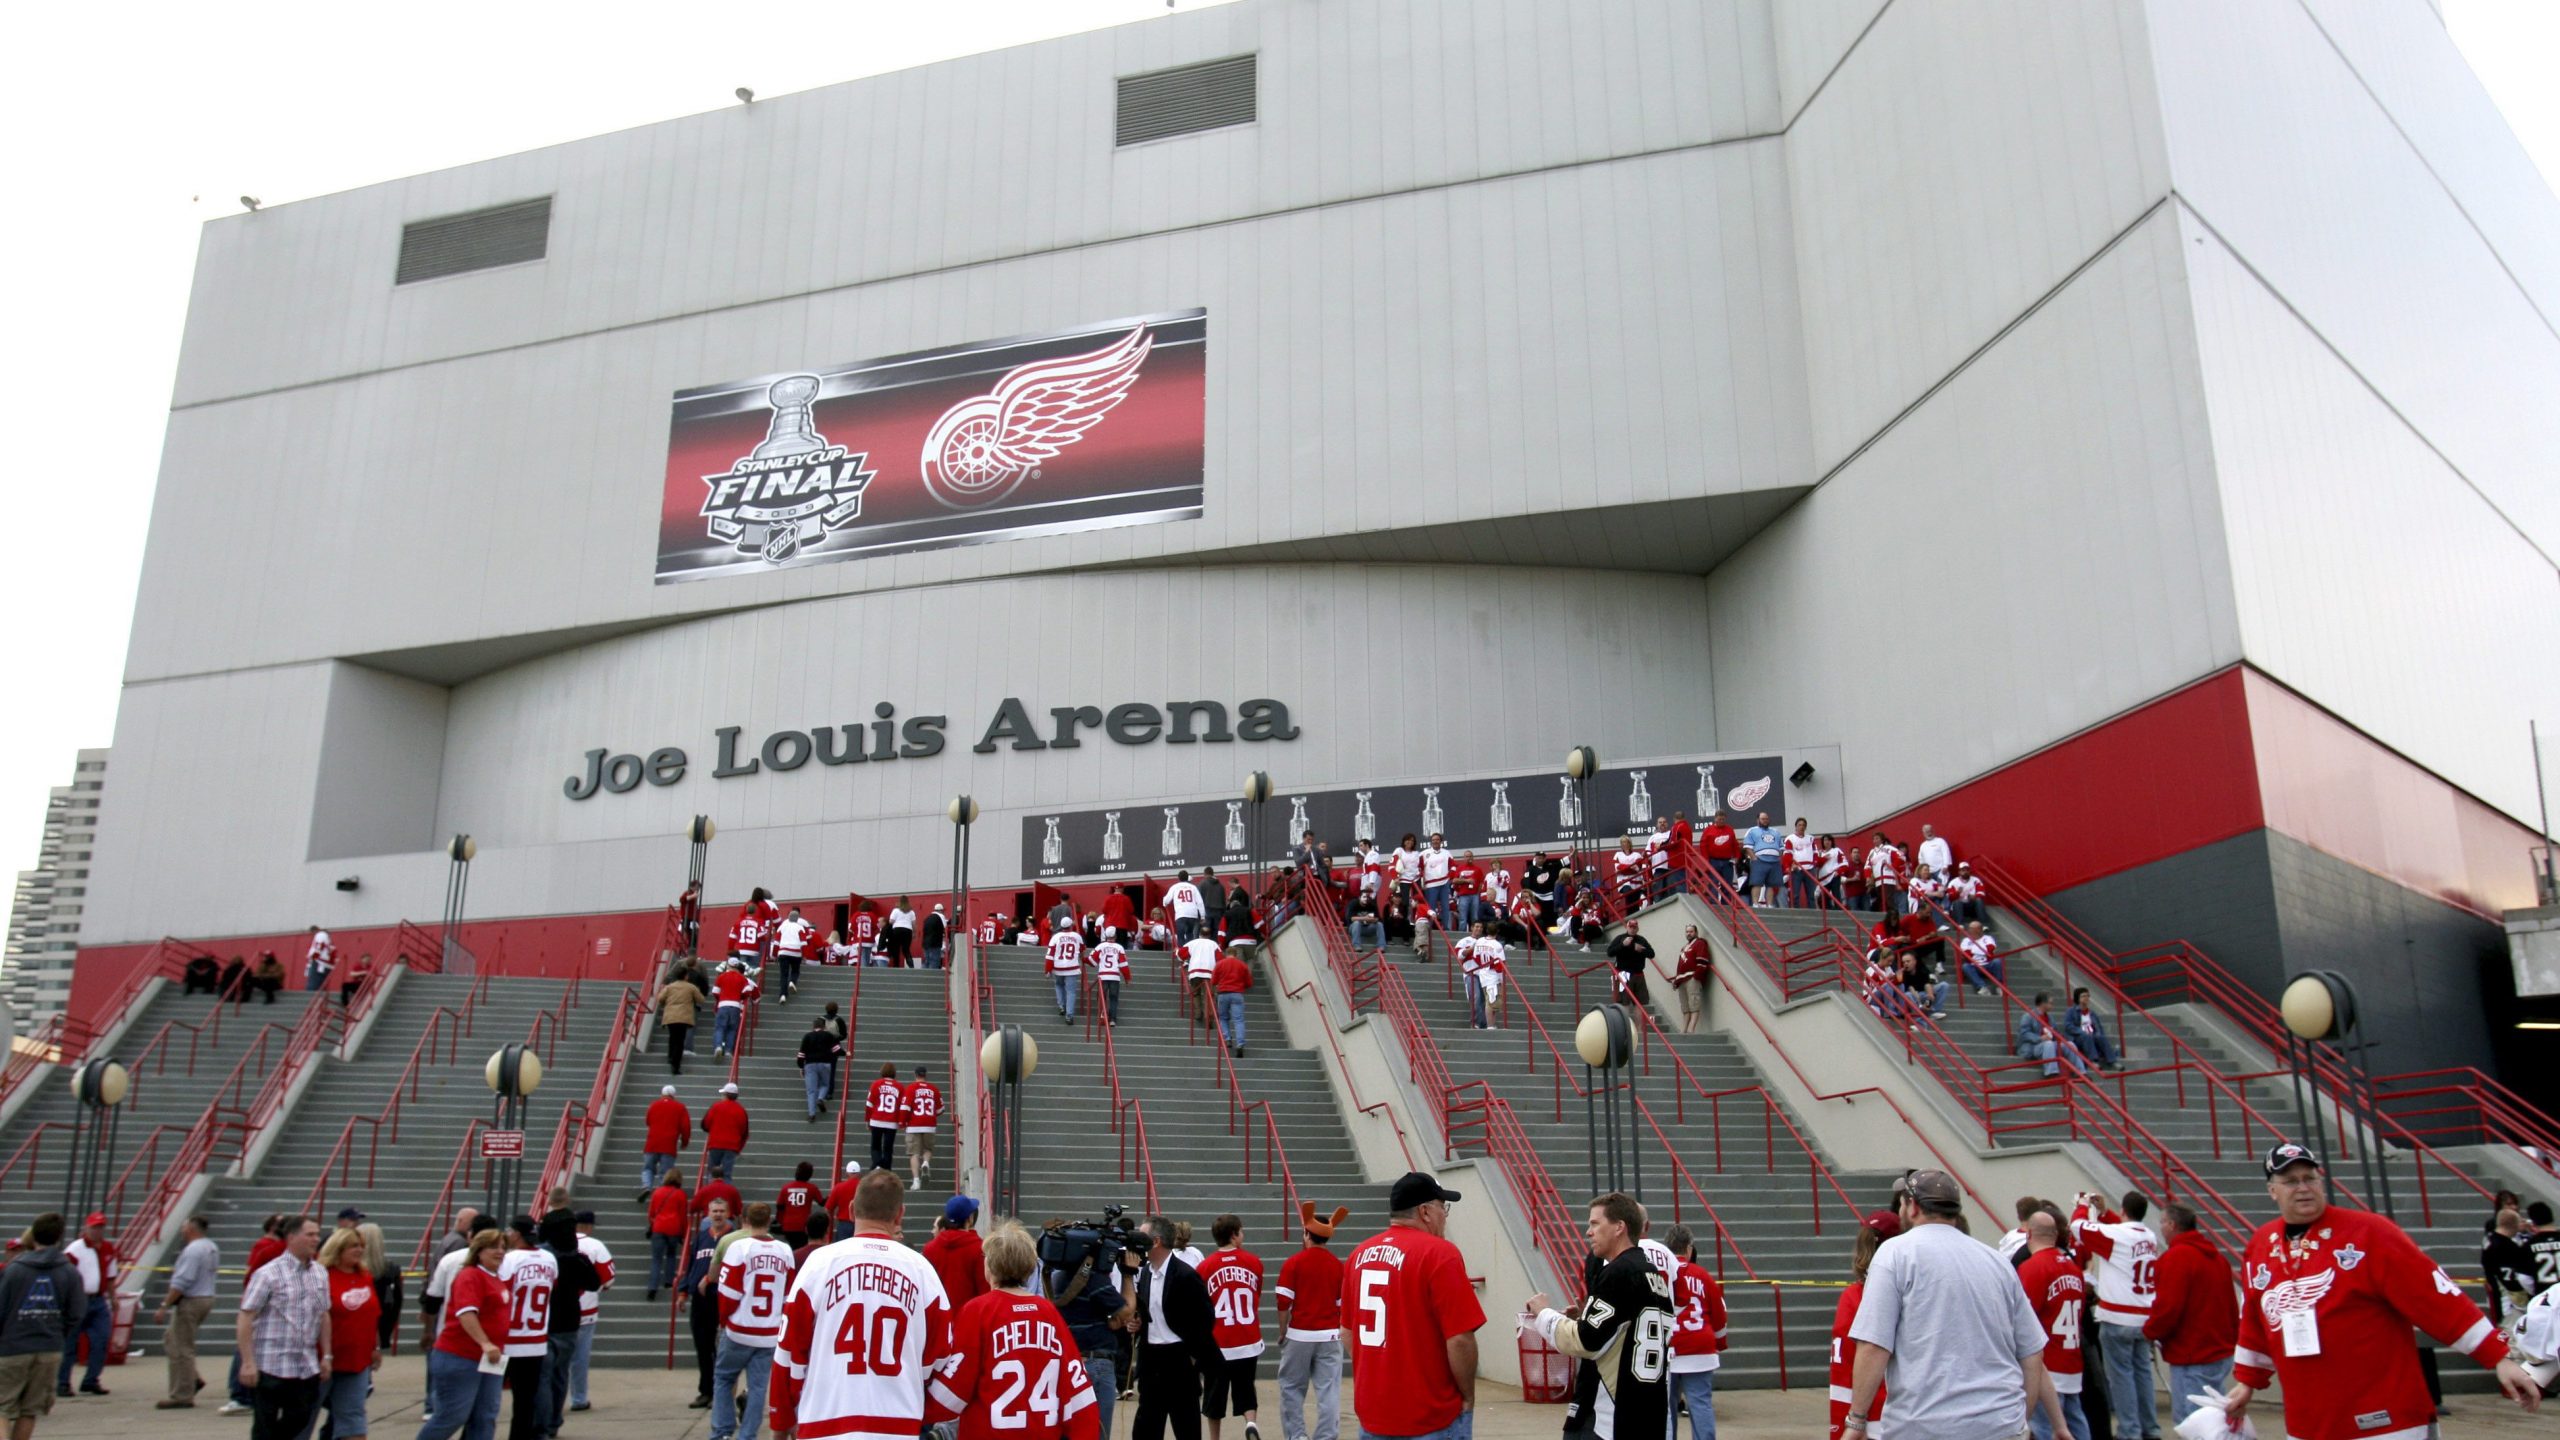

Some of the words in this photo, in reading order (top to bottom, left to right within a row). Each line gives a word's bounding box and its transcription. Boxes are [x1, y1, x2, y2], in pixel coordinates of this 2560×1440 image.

[710, 461, 863, 507] FINAL
[754, 503, 814, 518] 2009
[769, 529, 795, 556] NHL
[563, 745, 687, 801] Joe
[711, 702, 946, 778] Louis
[973, 697, 1299, 753] Arena
[1488, 836, 1517, 844] 1996-97
[1100, 863, 1126, 872] 1936-37
[1177, 889, 1193, 902] 40
[739, 927, 757, 944] 19
[857, 922, 872, 938] 19
[1058, 943, 1075, 960] 19
[1104, 954, 1113, 968] 5
[877, 1093, 896, 1113] 19
[913, 1098, 935, 1116] 33
[788, 1192, 806, 1206] 40
[1355, 1245, 1406, 1271] LIDSTROM
[751, 1273, 775, 1317] 5
[825, 1263, 919, 1316] ZETTERBERG
[509, 1285, 550, 1330] 19
[1214, 1287, 1255, 1326] 40
[1359, 1269, 1390, 1347] 5
[834, 1302, 908, 1377] 40
[992, 1320, 1063, 1359] CHELIOS
[1067, 1359, 1088, 1388] 2
[990, 1358, 1061, 1429] 24
